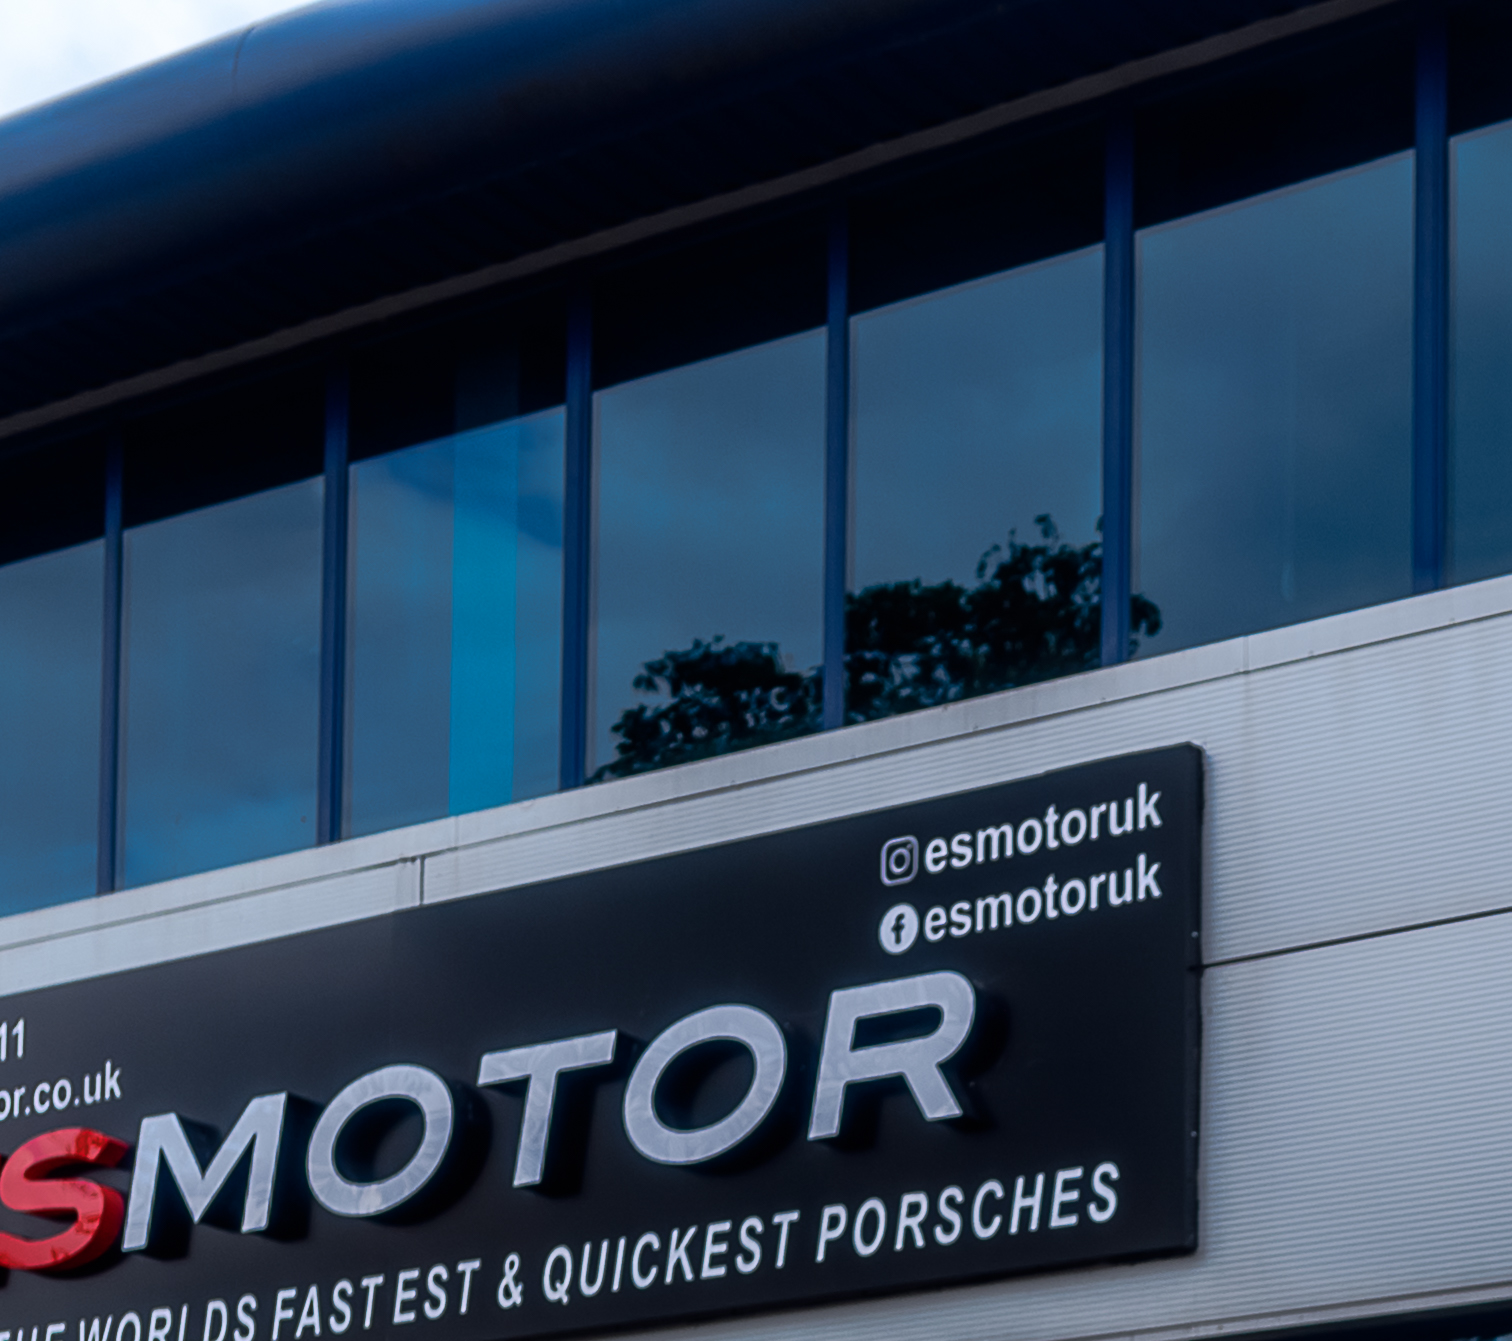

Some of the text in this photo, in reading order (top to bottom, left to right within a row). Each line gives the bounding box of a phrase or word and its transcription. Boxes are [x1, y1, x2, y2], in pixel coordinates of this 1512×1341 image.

[924, 782, 1163, 874] esmotoruk
[923, 853, 1162, 943] esmotoruk
[496, 1252, 524, 1309] &
[543, 1210, 800, 1306] QUICKEST
[816, 1161, 1121, 1264] PORSCHES
